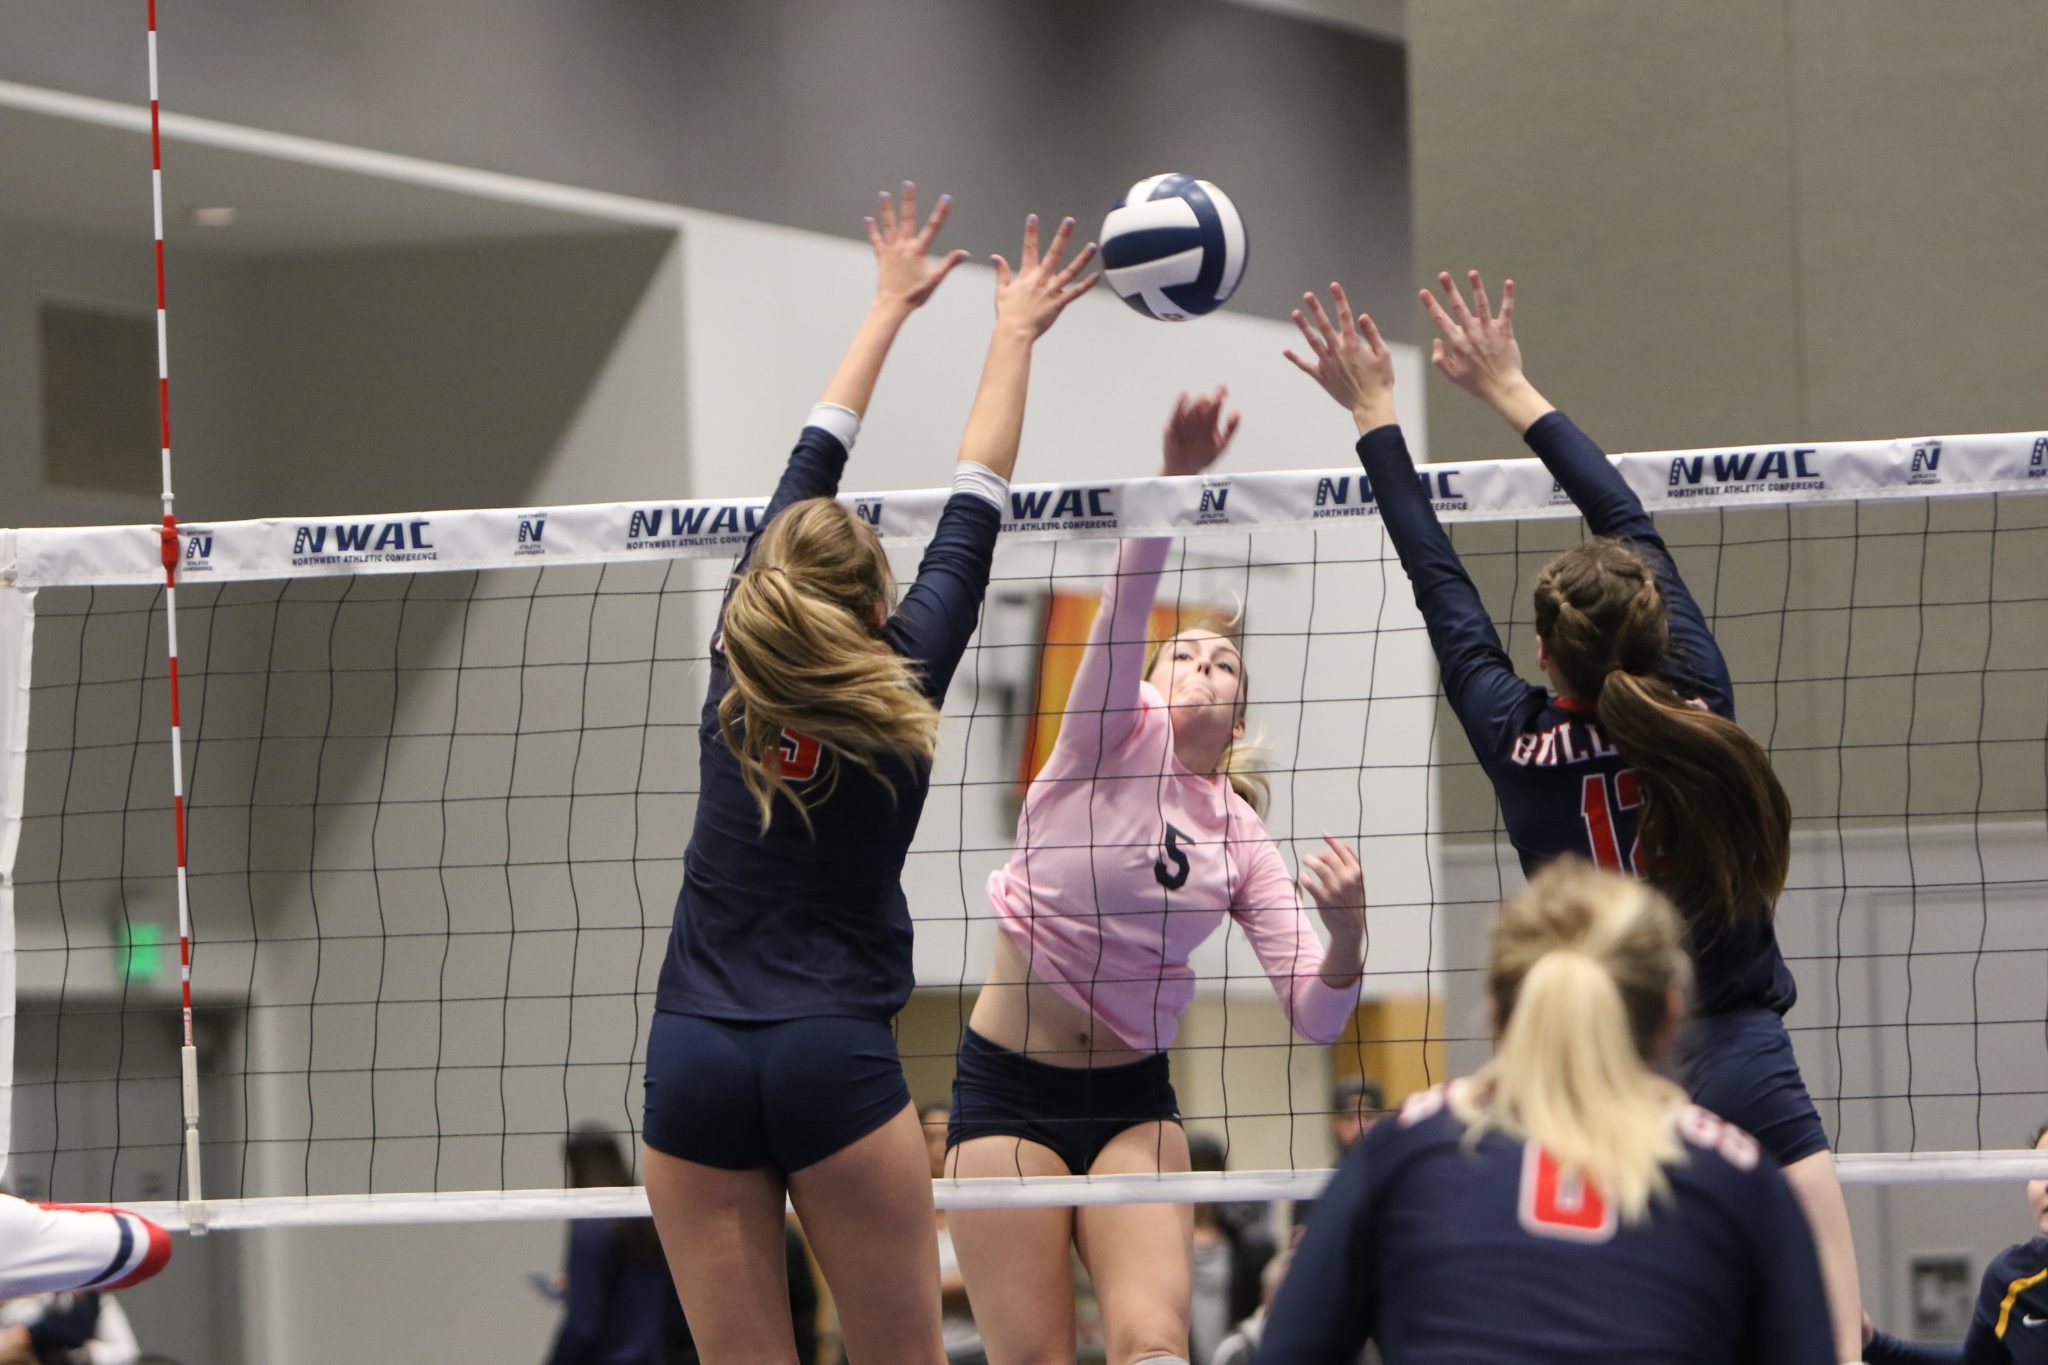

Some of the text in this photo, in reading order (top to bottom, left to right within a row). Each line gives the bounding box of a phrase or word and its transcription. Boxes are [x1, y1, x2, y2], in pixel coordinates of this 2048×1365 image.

[1669, 449, 1820, 485] NWAC
[1911, 447, 1941, 471] N
[1316, 471, 1463, 505] NC
[1667, 481, 1825, 498] NORTHWEST ATHLETIC CONFERENCE
[1011, 488, 1114, 519] WAC
[1200, 489, 1228, 511] N
[629, 506, 765, 538] NWAC
[1313, 507, 1366, 518] NORTHWEST
[519, 520, 545, 542] N
[1021, 522, 1060, 531] ATHLETIC
[1063, 519, 1118, 530] CONFERENCE
[187, 536, 212, 558] N
[294, 521, 434, 554] NWAC
[626, 535, 749, 550] NORTHWEST ATHLETIC CONFE
[292, 552, 438, 566] NORTHWEST ATHLETIC CONFERENCE
[1511, 720, 1619, 766] BULL
[1154, 821, 1196, 891] 5
